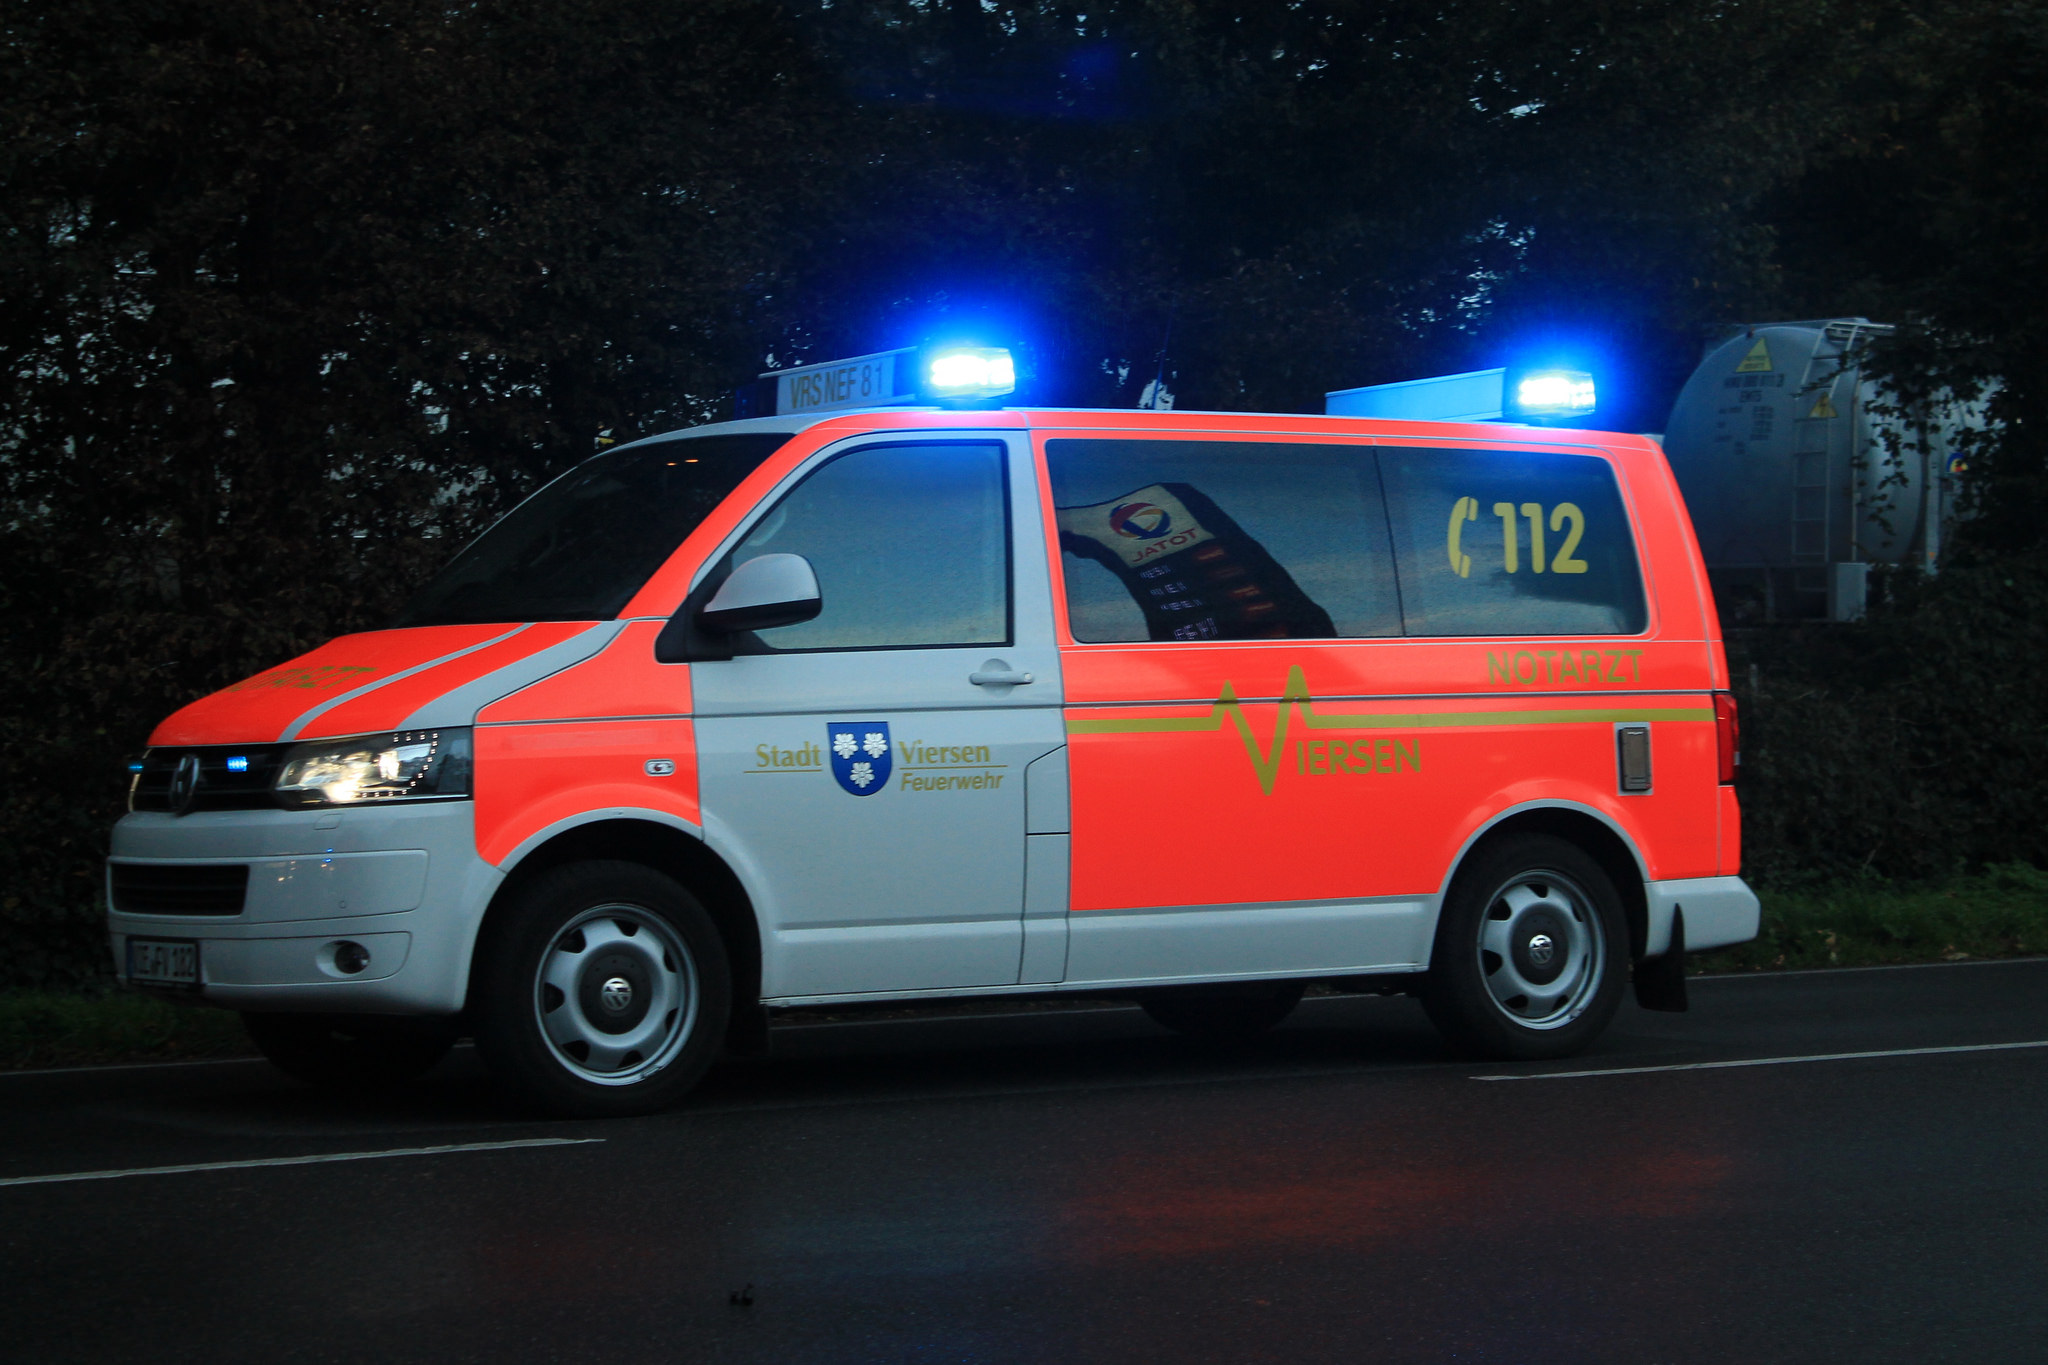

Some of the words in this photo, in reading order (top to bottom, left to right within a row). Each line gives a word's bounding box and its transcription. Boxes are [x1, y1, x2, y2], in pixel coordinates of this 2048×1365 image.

[789, 373, 822, 409] VRS
[825, 367, 857, 402] NEF
[860, 362, 883, 397] 81
[1493, 502, 1588, 574] 112
[1487, 650, 1643, 685] NOTARZT
[756, 741, 822, 768] Stadt
[898, 740, 991, 764] Viersen
[901, 771, 1005, 791] Feuerwehr
